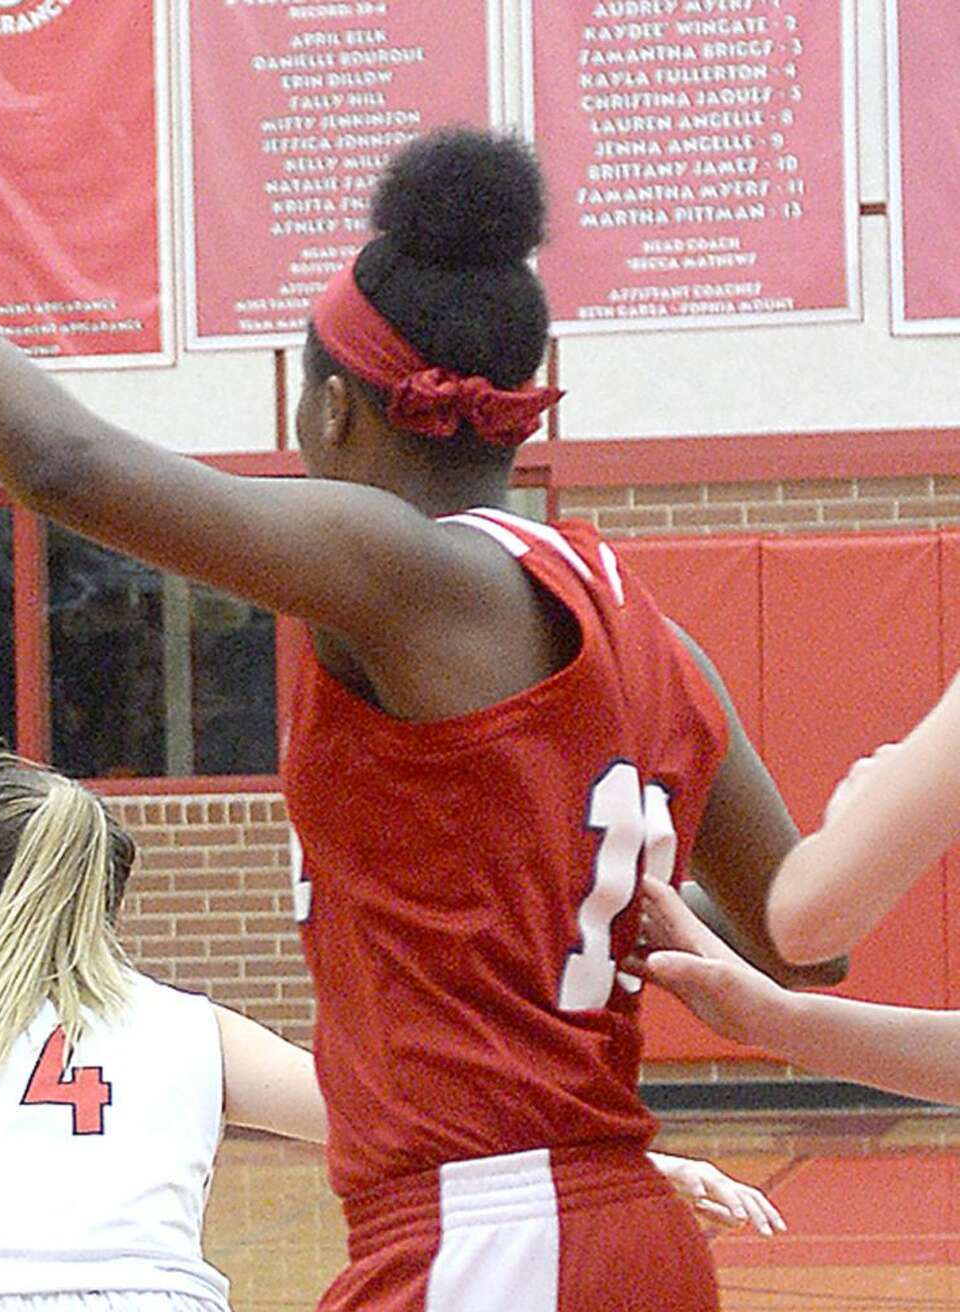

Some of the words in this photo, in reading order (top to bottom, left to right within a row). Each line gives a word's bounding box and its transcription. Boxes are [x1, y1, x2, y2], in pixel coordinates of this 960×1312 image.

[674, 15, 768, 38] WINGATE
[290, 32, 340, 49] APRIL
[578, 45, 698, 67] SAMANTHA
[702, 38, 773, 60] BRIGGS
[252, 51, 335, 71] DANIELLE
[339, 46, 425, 66] BOURQUE
[280, 73, 323, 90] ERIN
[326, 70, 393, 88] DILLOW
[578, 69, 650, 89] KAYLA
[653, 63, 768, 85] FULLERTON
[581, 91, 691, 112] CHRISTINA
[695, 85, 773, 106] JAQUES
[591, 114, 673, 135] LAUREN
[677, 109, 765, 130] ANGELLE
[261, 135, 332, 154] JESSICA
[594, 139, 662, 159] JENNA
[667, 133, 755, 155] ANGELLE
[586, 159, 688, 182] BRITTANY
[692, 156, 760, 177] JAMES
[777, 154, 799, 173] 10
[265, 175, 340, 195] NATALIE
[576, 184, 695, 206] SAMANTHA
[699, 178, 771, 200] MYERS
[580, 208, 669, 228] MARTHA
[673, 202, 767, 223] PITTMAN
[20, 1022, 112, 1136] 4
